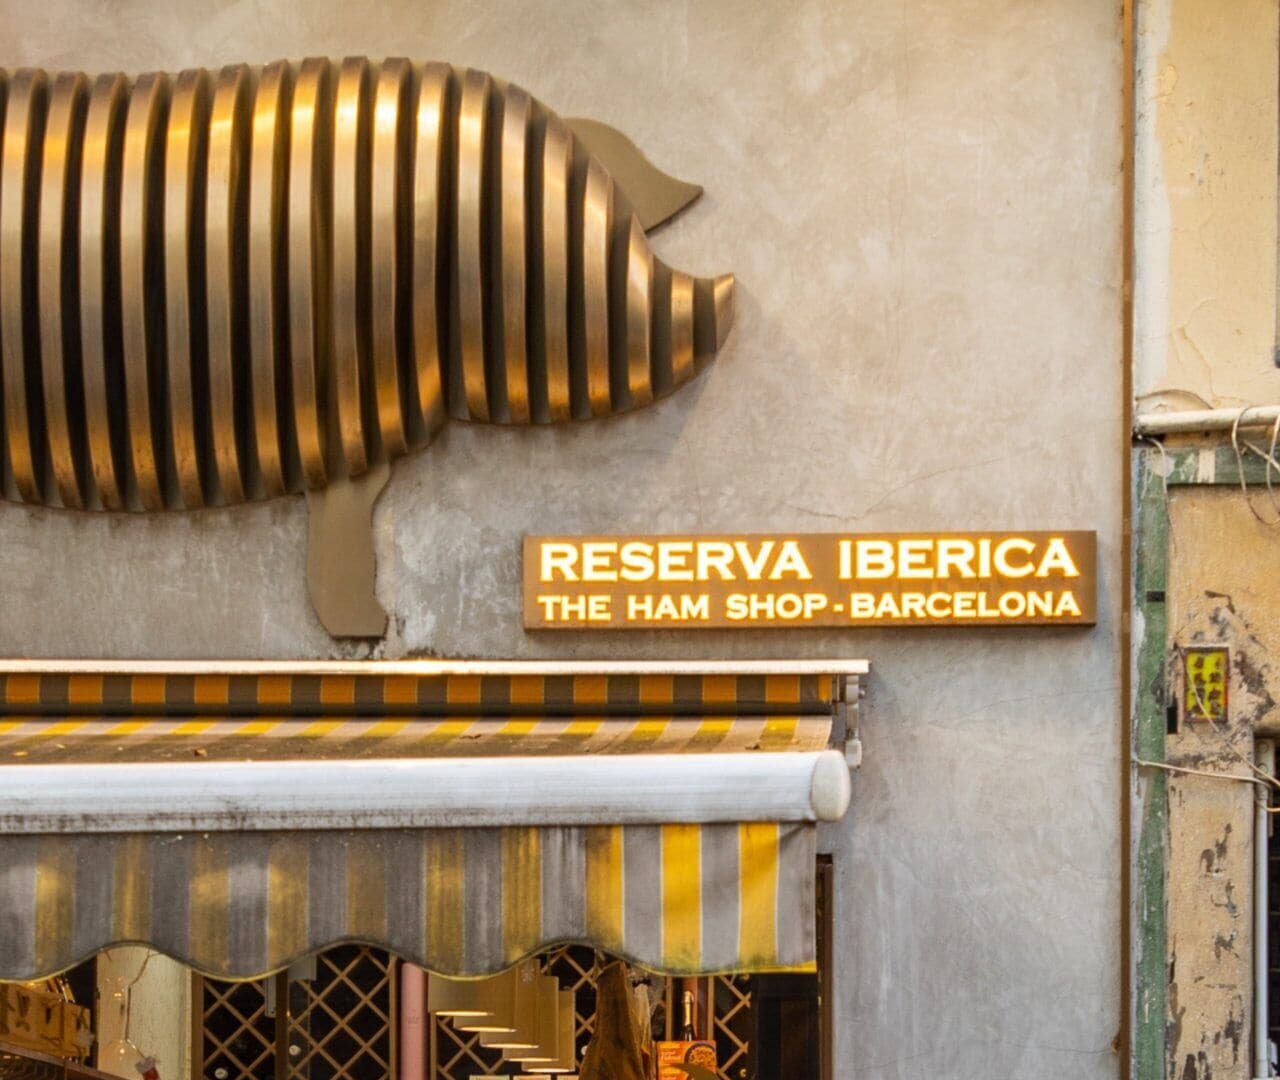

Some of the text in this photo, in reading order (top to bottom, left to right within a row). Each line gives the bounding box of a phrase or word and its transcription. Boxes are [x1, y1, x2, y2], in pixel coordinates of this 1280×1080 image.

[540, 538, 1080, 582] RESERVA IBERICA
[537, 595, 612, 621] THE
[626, 594, 710, 620] HAM
